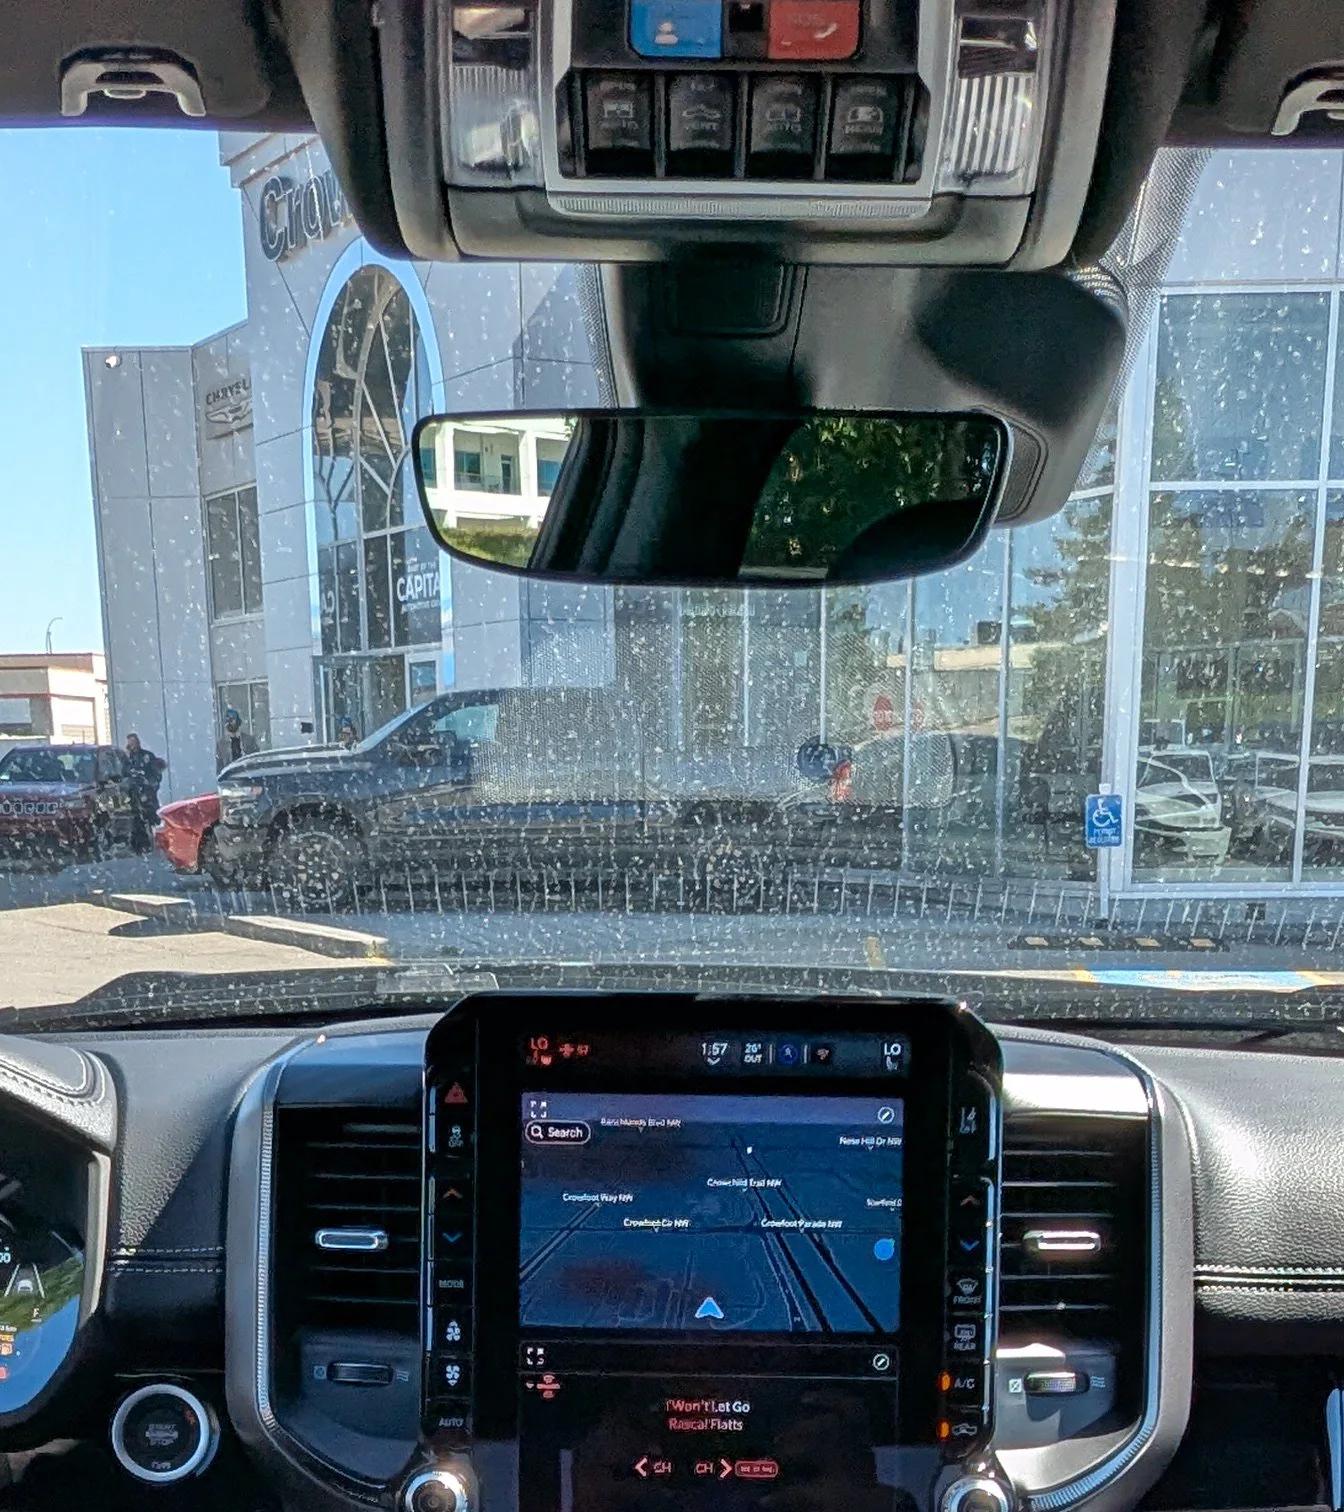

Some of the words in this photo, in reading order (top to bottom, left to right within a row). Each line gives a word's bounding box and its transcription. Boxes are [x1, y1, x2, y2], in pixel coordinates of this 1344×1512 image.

[206, 378, 252, 405] CHRYSL
[396, 571, 440, 602] CAPITA
[883, 1042, 902, 1057] LO
[547, 1126, 584, 1139] Search
[732, 1401, 751, 1413] Go
[438, 1415, 464, 1427] AUTO
